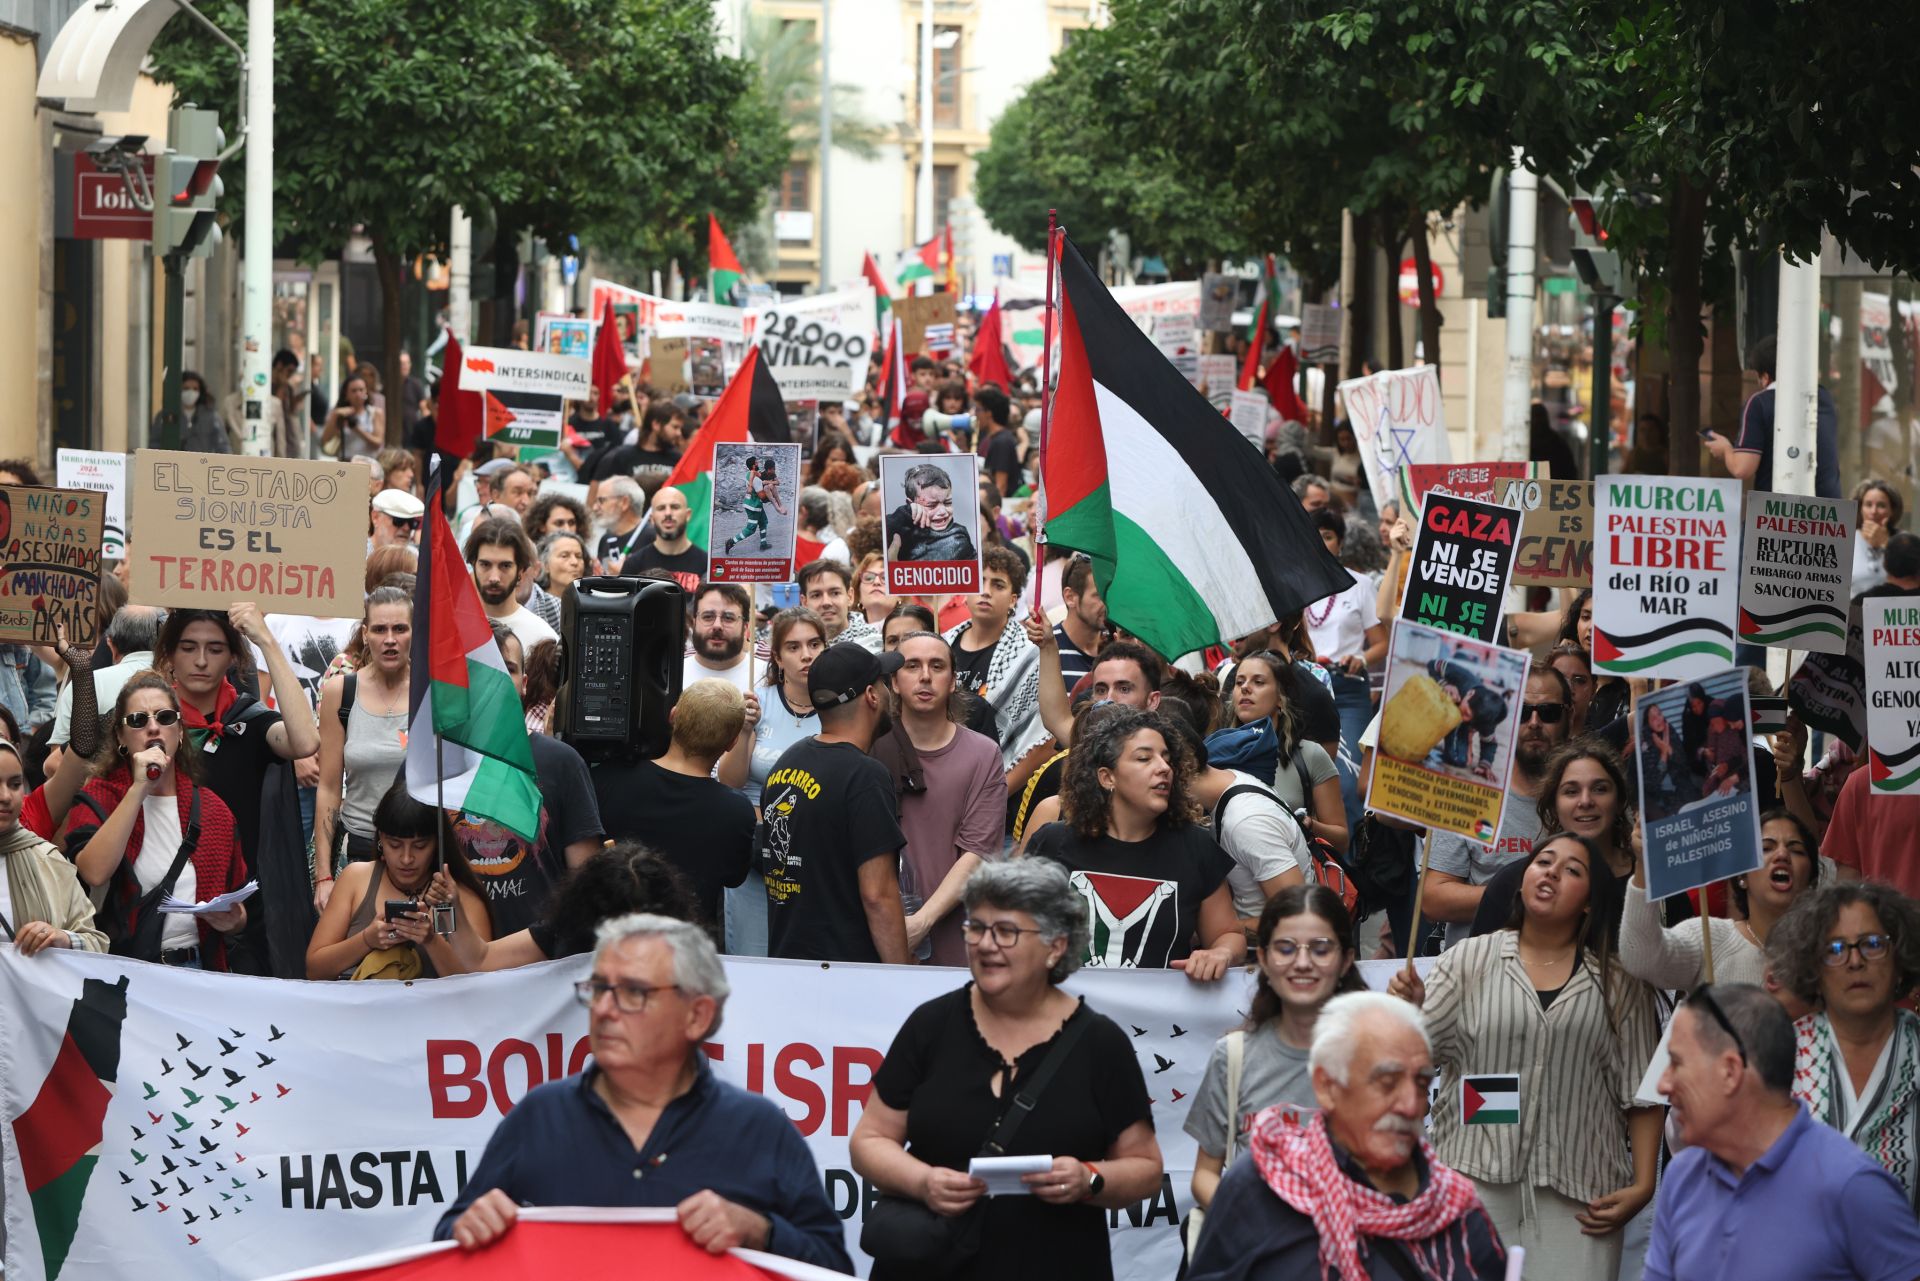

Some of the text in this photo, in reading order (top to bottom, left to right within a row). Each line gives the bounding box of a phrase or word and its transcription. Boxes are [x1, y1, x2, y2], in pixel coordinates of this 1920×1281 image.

[498, 366, 587, 384] INTERSINDICAL
[153, 463, 193, 493] EL
[1448, 467, 1491, 485] FREE
[28, 494, 91, 517] NIÑOS
[1501, 480, 1542, 511] NO
[1551, 484, 1581, 511] ES
[1609, 484, 1725, 512] MURCIA
[175, 497, 312, 529] SIONISTA
[1559, 515, 1583, 533] ES
[1765, 500, 1838, 522] MURCIA
[1427, 505, 1512, 546] GAZA
[1608, 514, 1727, 538] PALESTINA
[1756, 515, 1847, 538] PALESTINA
[199, 527, 281, 553] ES EL
[1610, 535, 1726, 571] LIBRE
[1758, 537, 1837, 559] RUPTURA
[5, 539, 102, 573] ASESINADAS
[1430, 540, 1498, 573] NI SE
[1757, 550, 1838, 569] RELACIONES
[12, 572, 95, 602] MANCHADAS
[150, 555, 335, 599] TERRORISTA
[894, 566, 972, 586] GENOCIDIO
[1420, 560, 1500, 595] VENDE
[1608, 571, 1718, 595] del RÍO al
[1750, 566, 1842, 584] EMBARGO ARMAS
[1640, 596, 1687, 616] MAR
[1754, 582, 1835, 602] SANCIONES
[1419, 592, 1487, 625] NI SE
[1883, 608, 1920, 626] MUR
[767, 768, 821, 800] MACARREO
[1395, 762, 1434, 782] PLANIFICADA
[1436, 775, 1450, 786] POR
[1451, 779, 1475, 793] ISRAEL
[1397, 774, 1430, 791] PRODUCIR
[1433, 784, 1490, 810] ENFERMEDADES,
[1400, 803, 1441, 823] PALESTINOS
[1452, 819, 1471, 830] GAZA
[1434, 800, 1478, 818] EXTERMINIO
[1655, 801, 1748, 839] ISRAEL ASESINO
[1665, 821, 1732, 852] de NIÑOS/AS
[1667, 838, 1733, 868] PALESTINOS
[280, 1150, 445, 1210] HASTA
